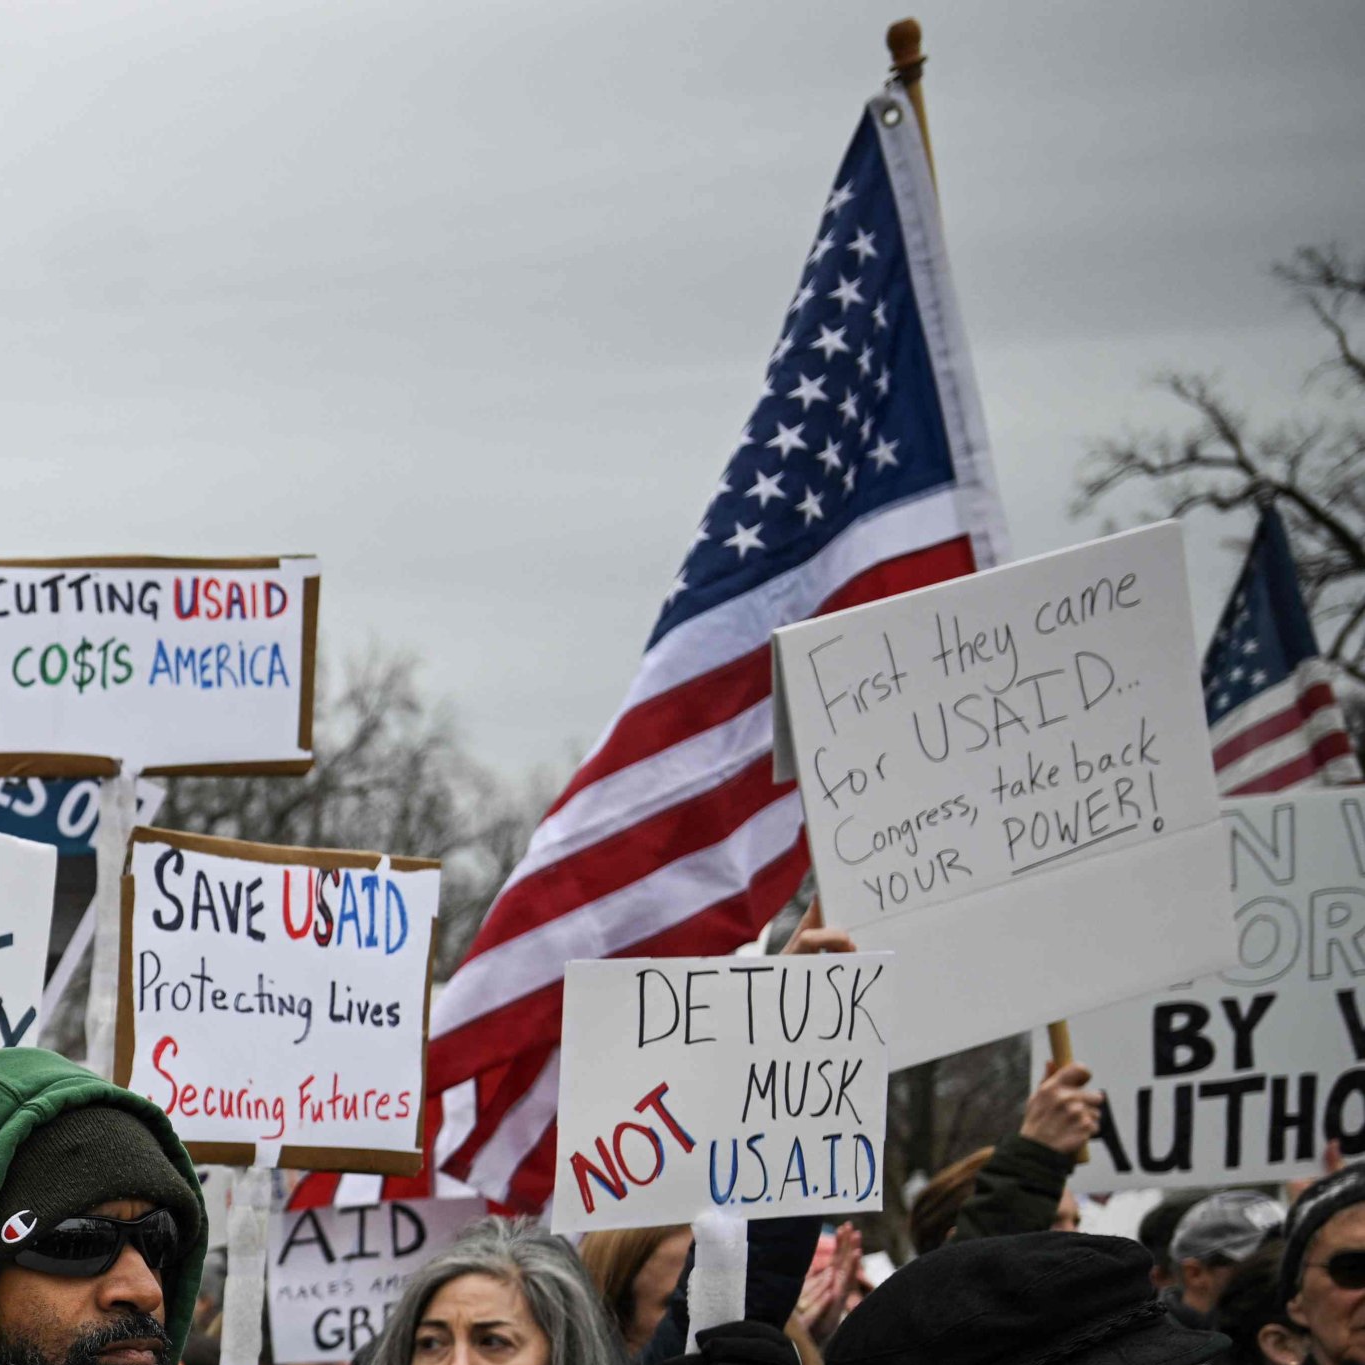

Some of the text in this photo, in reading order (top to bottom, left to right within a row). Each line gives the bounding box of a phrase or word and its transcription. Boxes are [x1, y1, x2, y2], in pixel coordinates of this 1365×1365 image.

[174, 576, 288, 621] USAID
[12, 636, 290, 694] CO$TS AMERICA
[808, 571, 1142, 735] First they came
[813, 746, 887, 809] for
[833, 717, 1162, 866] Congress, take back
[862, 770, 1165, 911] YOUR POWER!
[153, 848, 409, 955] SAVE USAID
[329, 980, 401, 1029] Lives
[1152, 990, 1277, 1078] BY
[150, 1035, 410, 1140] Securing Futures
[741, 1057, 863, 1125] MUSK
[570, 1080, 697, 1214] NOT
[277, 1202, 427, 1267] AID
